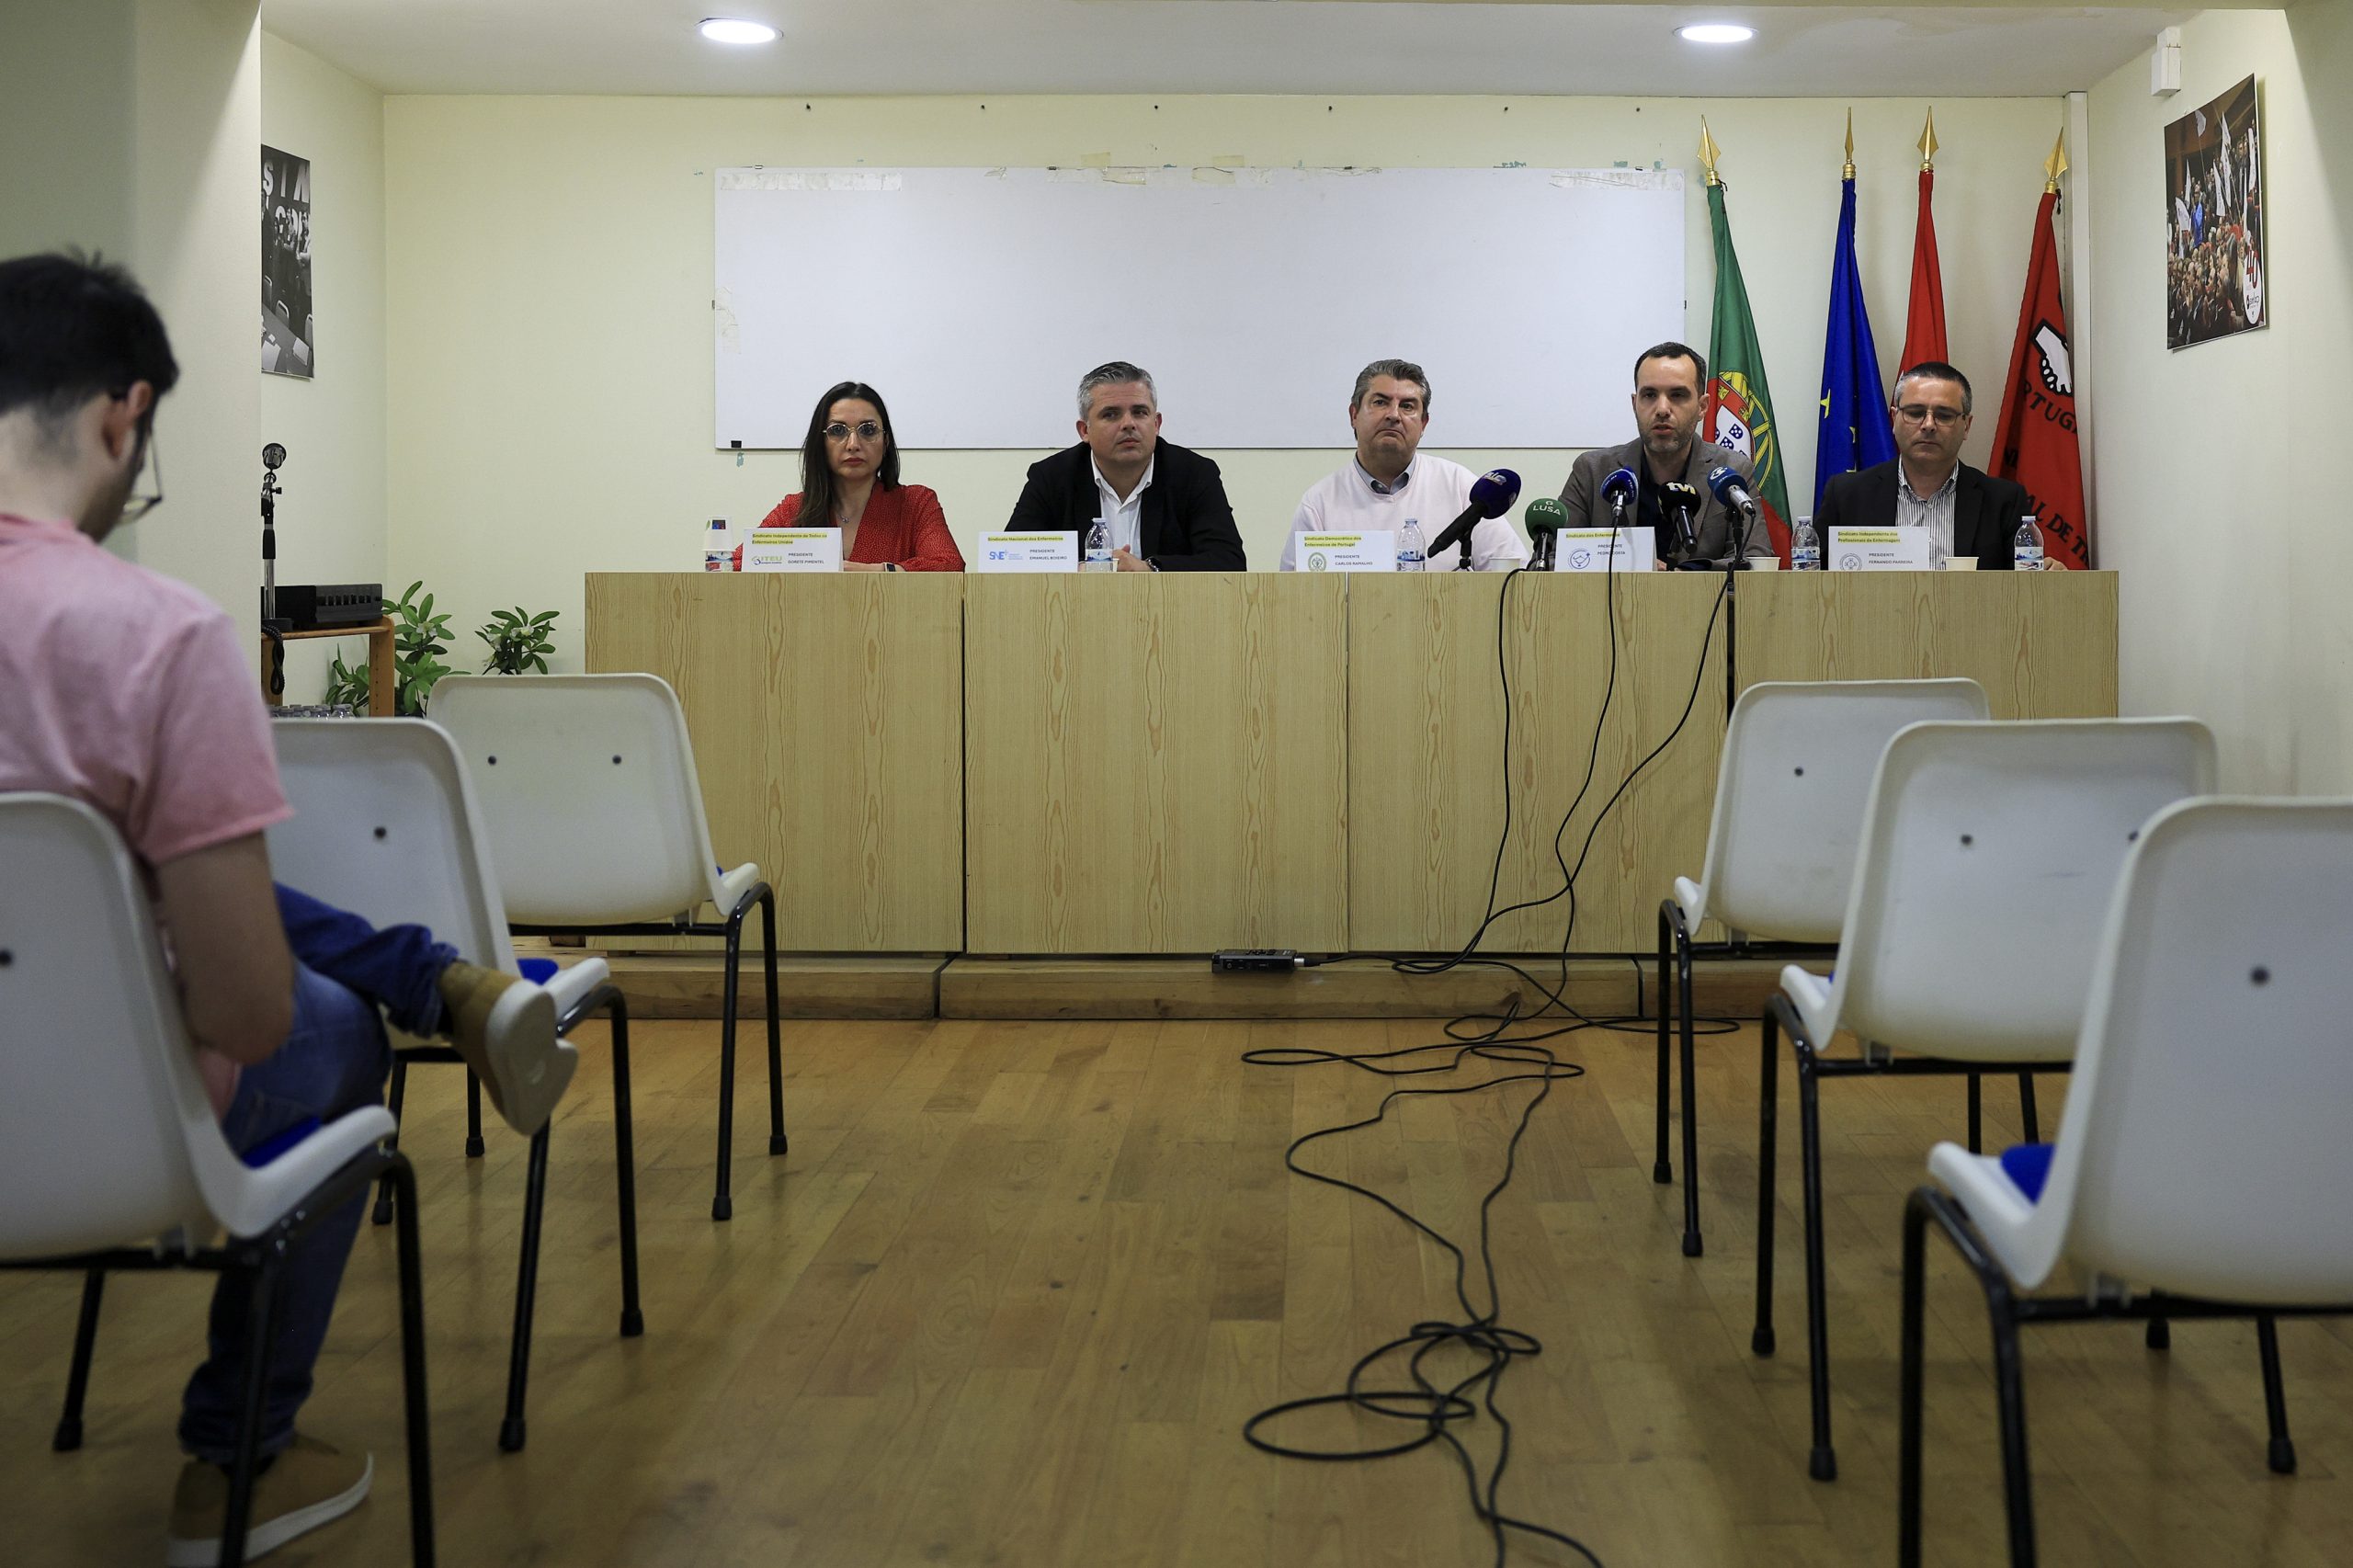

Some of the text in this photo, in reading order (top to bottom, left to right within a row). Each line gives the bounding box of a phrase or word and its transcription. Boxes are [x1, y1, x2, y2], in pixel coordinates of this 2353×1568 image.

[1533, 505, 1562, 516] LUSA
[2046, 513, 2074, 543] DE
[989, 551, 1006, 561] SNE
